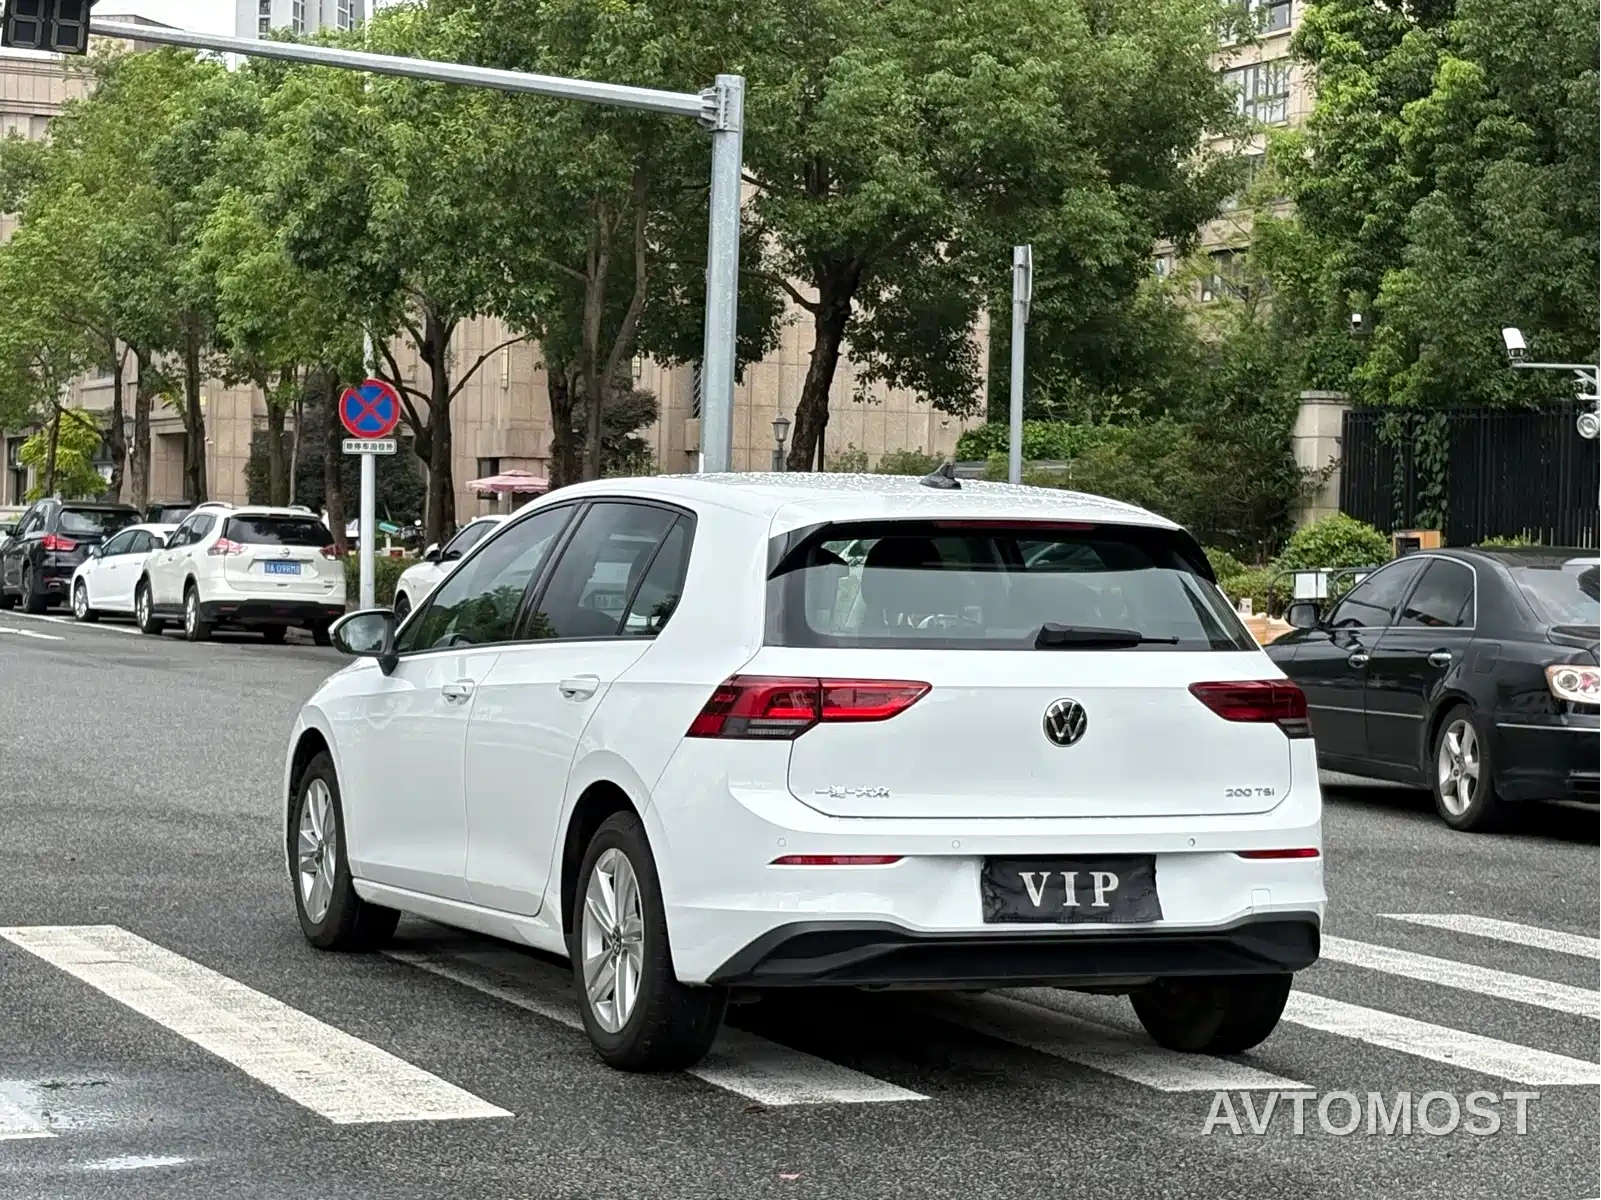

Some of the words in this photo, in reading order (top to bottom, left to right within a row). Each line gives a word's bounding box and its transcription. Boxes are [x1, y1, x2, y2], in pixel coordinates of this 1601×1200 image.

[1224, 788, 1252, 797] 200
[1254, 787, 1275, 796] TSI
[1018, 871, 1119, 907] VIP
